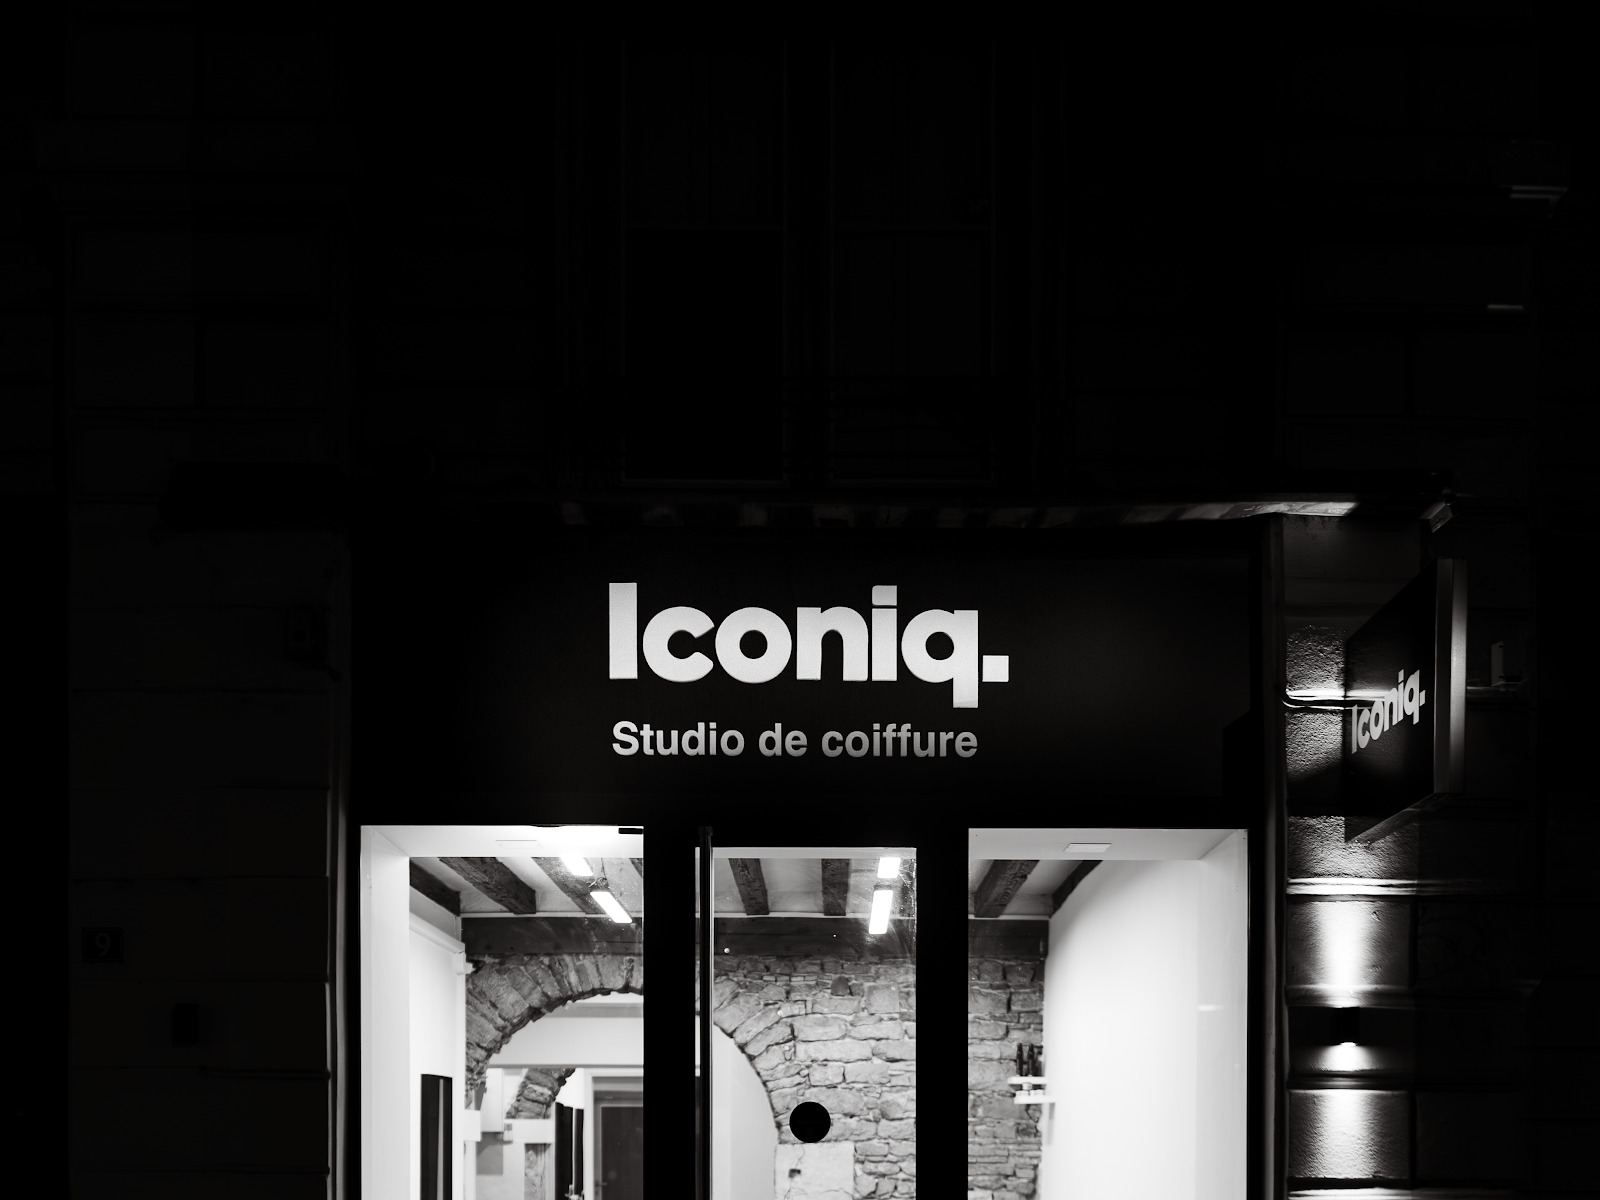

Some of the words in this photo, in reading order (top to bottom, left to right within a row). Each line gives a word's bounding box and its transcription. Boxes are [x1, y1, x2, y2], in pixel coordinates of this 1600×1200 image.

[608, 582, 1010, 709] Iconiq.
[611, 720, 745, 756] Studio
[758, 722, 808, 756] de
[820, 723, 979, 758] coiffure
[1351, 668, 1426, 755] Iconiq.
